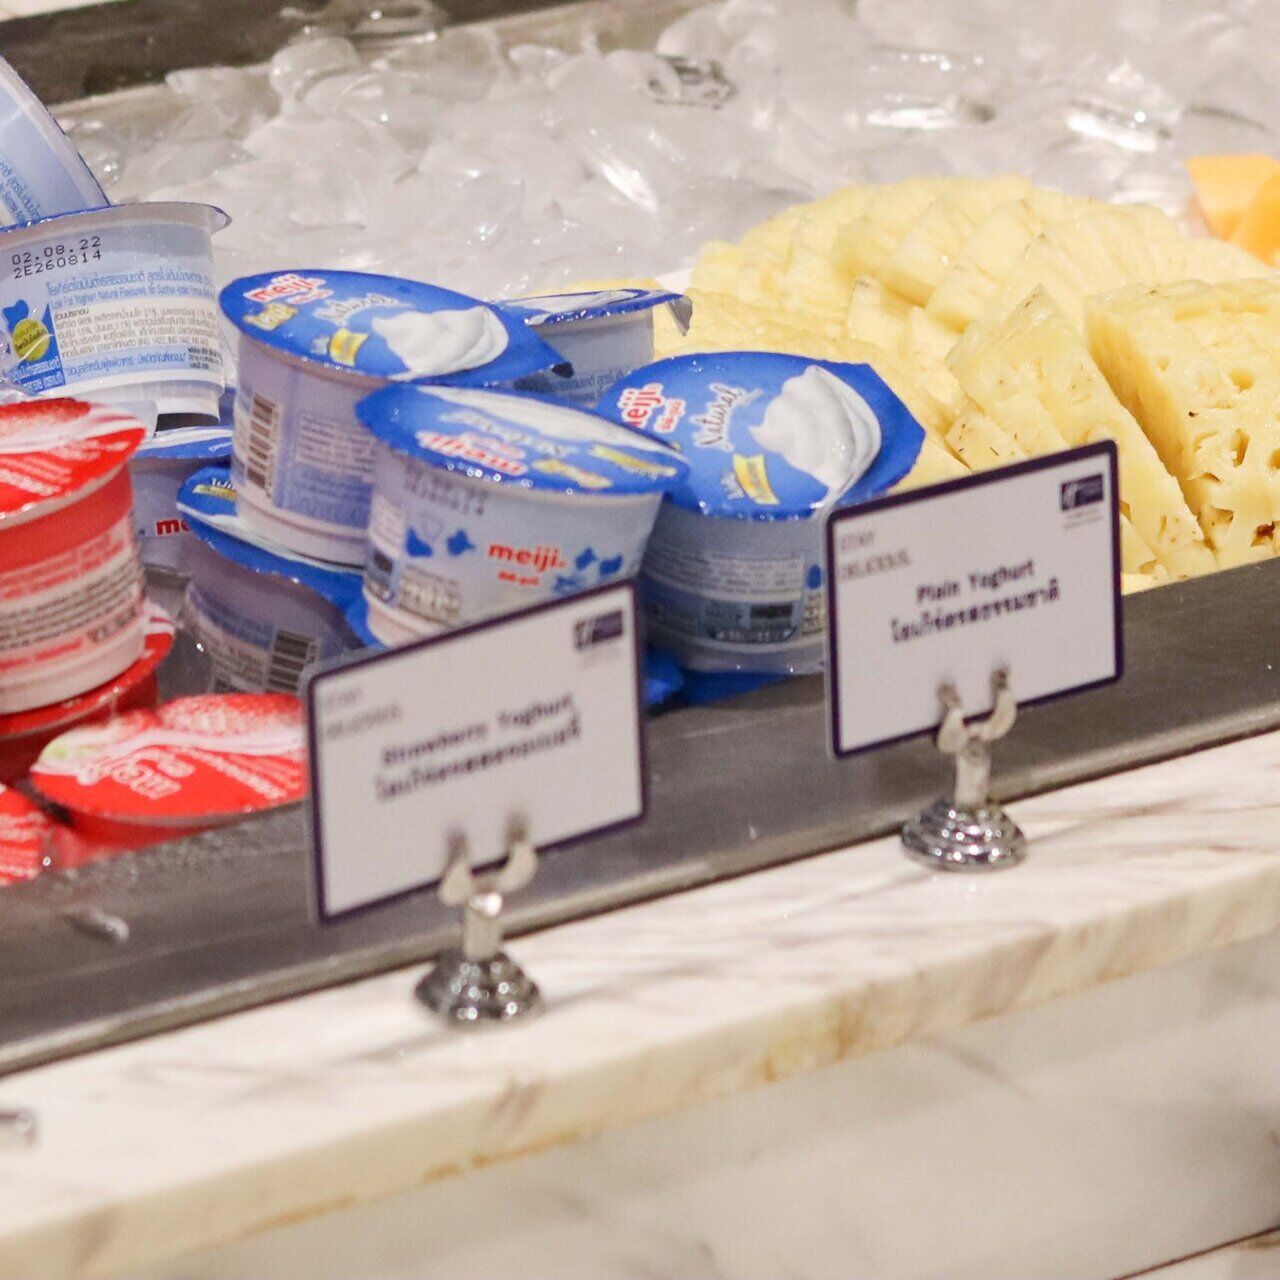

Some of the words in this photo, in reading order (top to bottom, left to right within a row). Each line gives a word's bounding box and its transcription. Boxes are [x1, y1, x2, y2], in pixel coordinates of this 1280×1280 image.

[11, 235, 103, 266] 02.08.22
[13, 249, 103, 280] 2E260814
[622, 384, 663, 427] eiji
[488, 542, 561, 573] meiji
[917, 580, 960, 604] Plain
[968, 558, 1034, 592] Yoghurt
